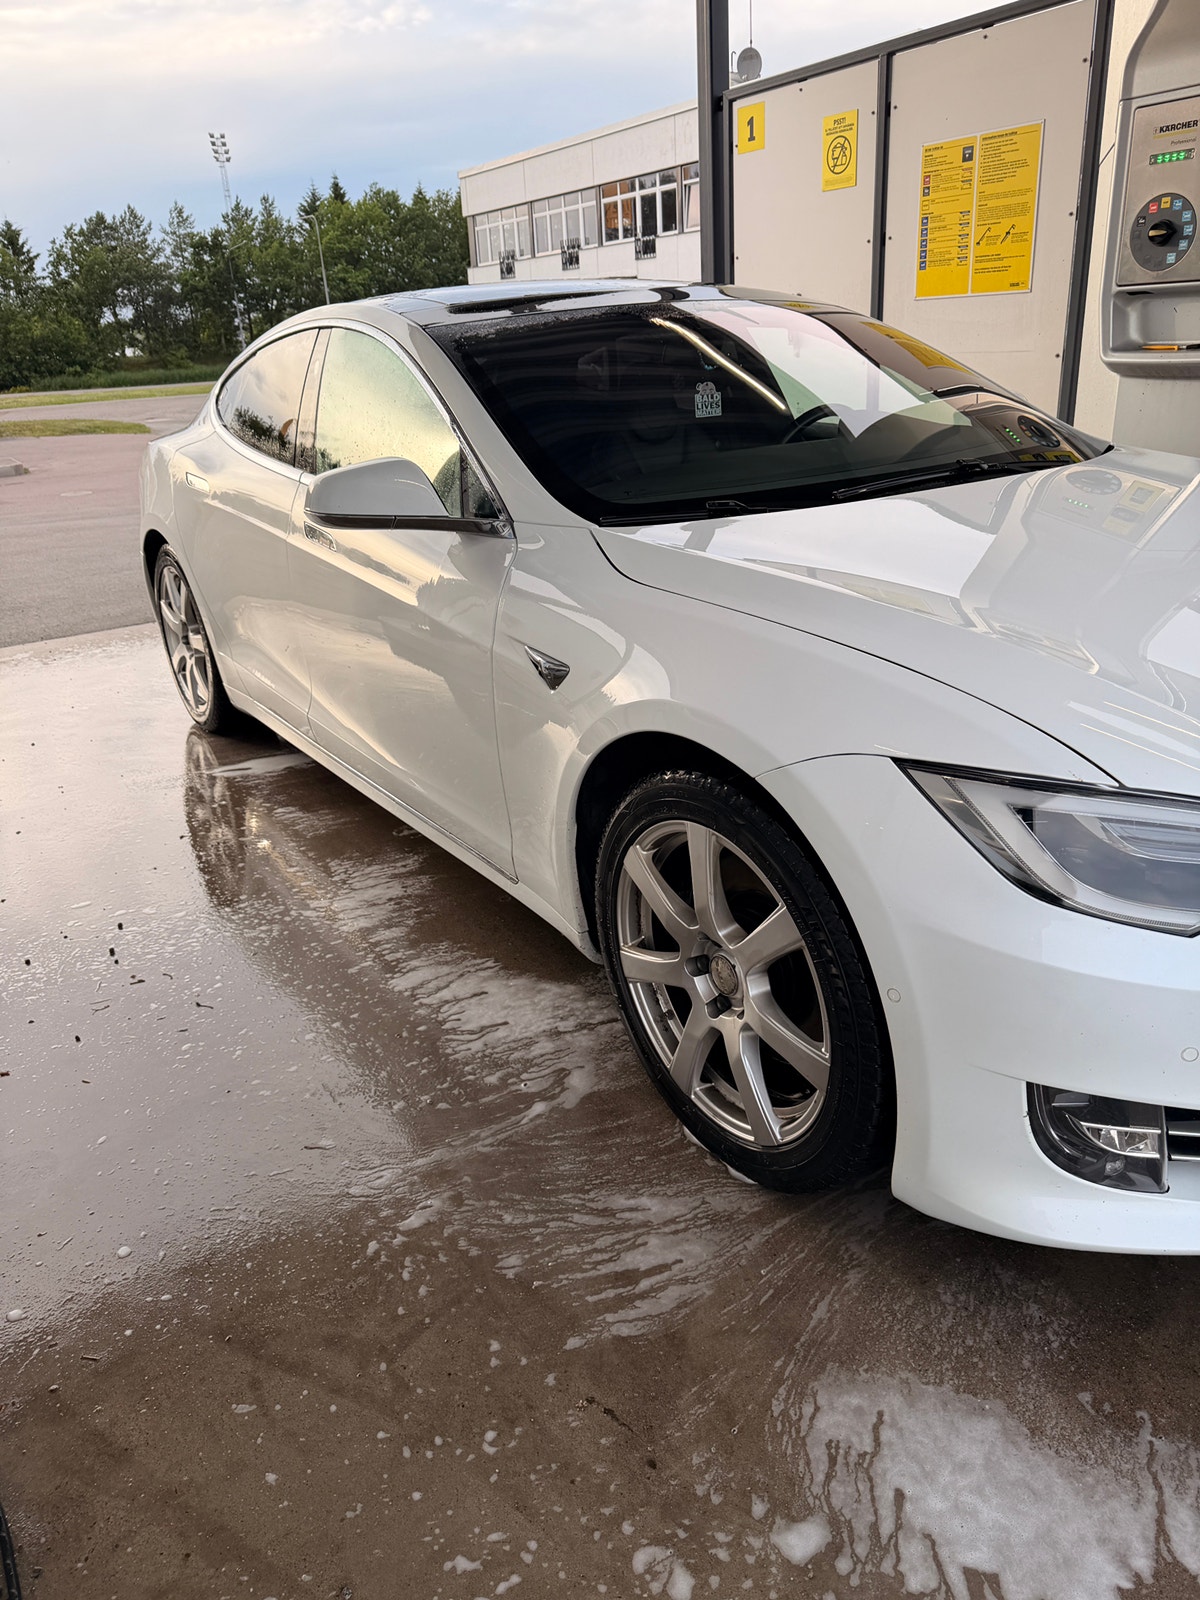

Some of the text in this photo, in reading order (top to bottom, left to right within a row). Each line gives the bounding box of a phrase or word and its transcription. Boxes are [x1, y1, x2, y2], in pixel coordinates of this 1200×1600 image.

[747, 116, 756, 142] 1
[1159, 119, 1198, 133] KÄRCHER
[697, 394, 720, 402] BALD
[697, 401, 720, 409] LIVES
